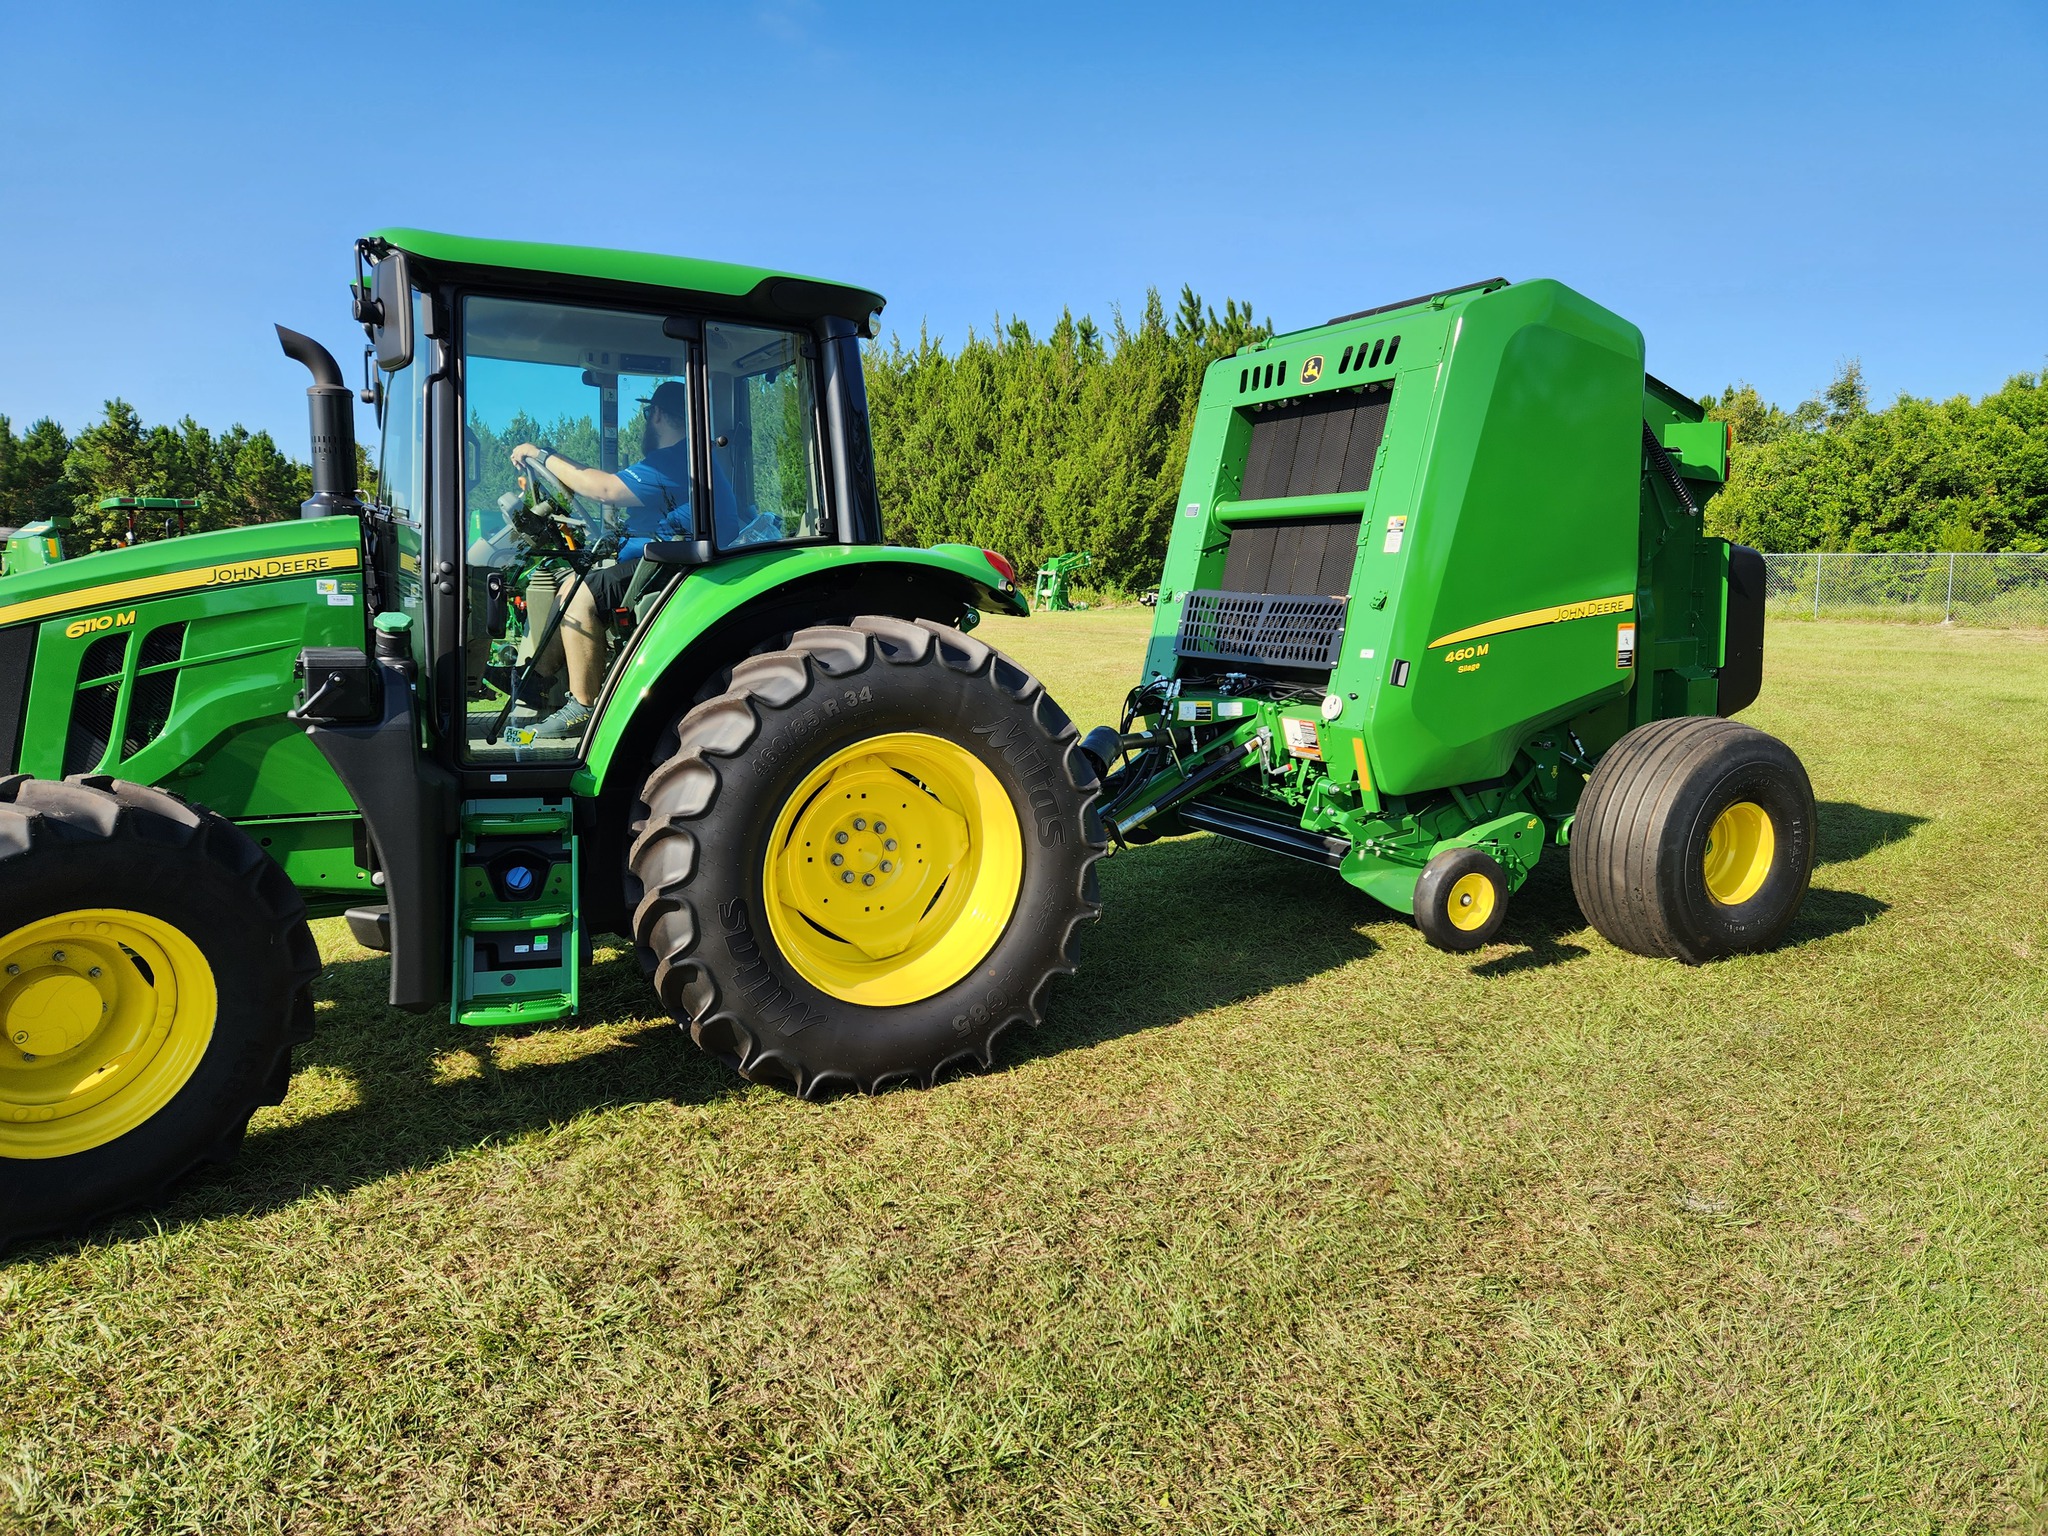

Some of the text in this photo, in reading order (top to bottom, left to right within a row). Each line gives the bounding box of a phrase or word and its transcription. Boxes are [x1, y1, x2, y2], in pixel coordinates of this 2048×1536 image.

[206, 556, 329, 584] JOHN DEERE
[65, 610, 137, 639] 6110 M
[1554, 600, 1625, 621] JOHN DEERE
[1444, 642, 1490, 663] 460 M
[751, 685, 874, 777] 460/85 R 34
